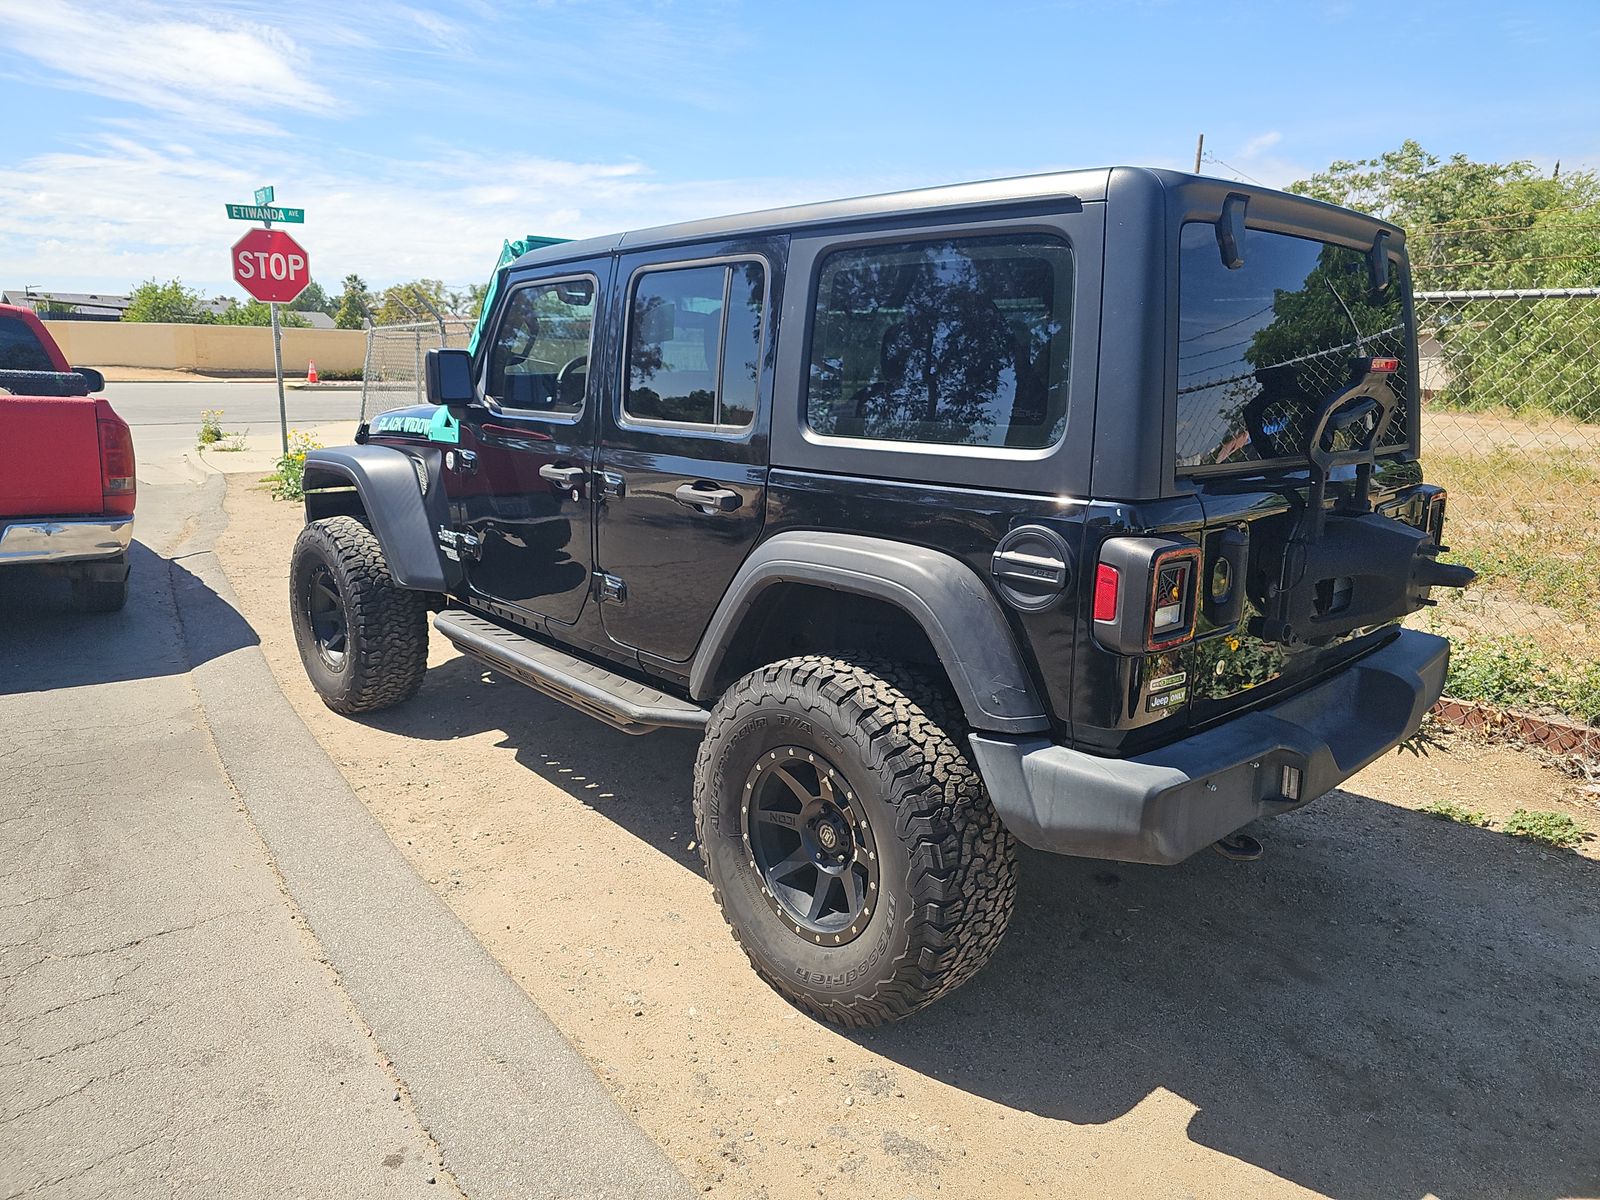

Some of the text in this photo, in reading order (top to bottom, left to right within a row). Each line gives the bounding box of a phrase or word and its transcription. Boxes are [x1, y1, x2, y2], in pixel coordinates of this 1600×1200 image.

[232, 206, 286, 220] ETIWANDA
[238, 250, 305, 281] STOP
[378, 416, 405, 431] BLACK
[1151, 691, 1185, 707] Jeep ONLY
[769, 812, 796, 827] ICON
